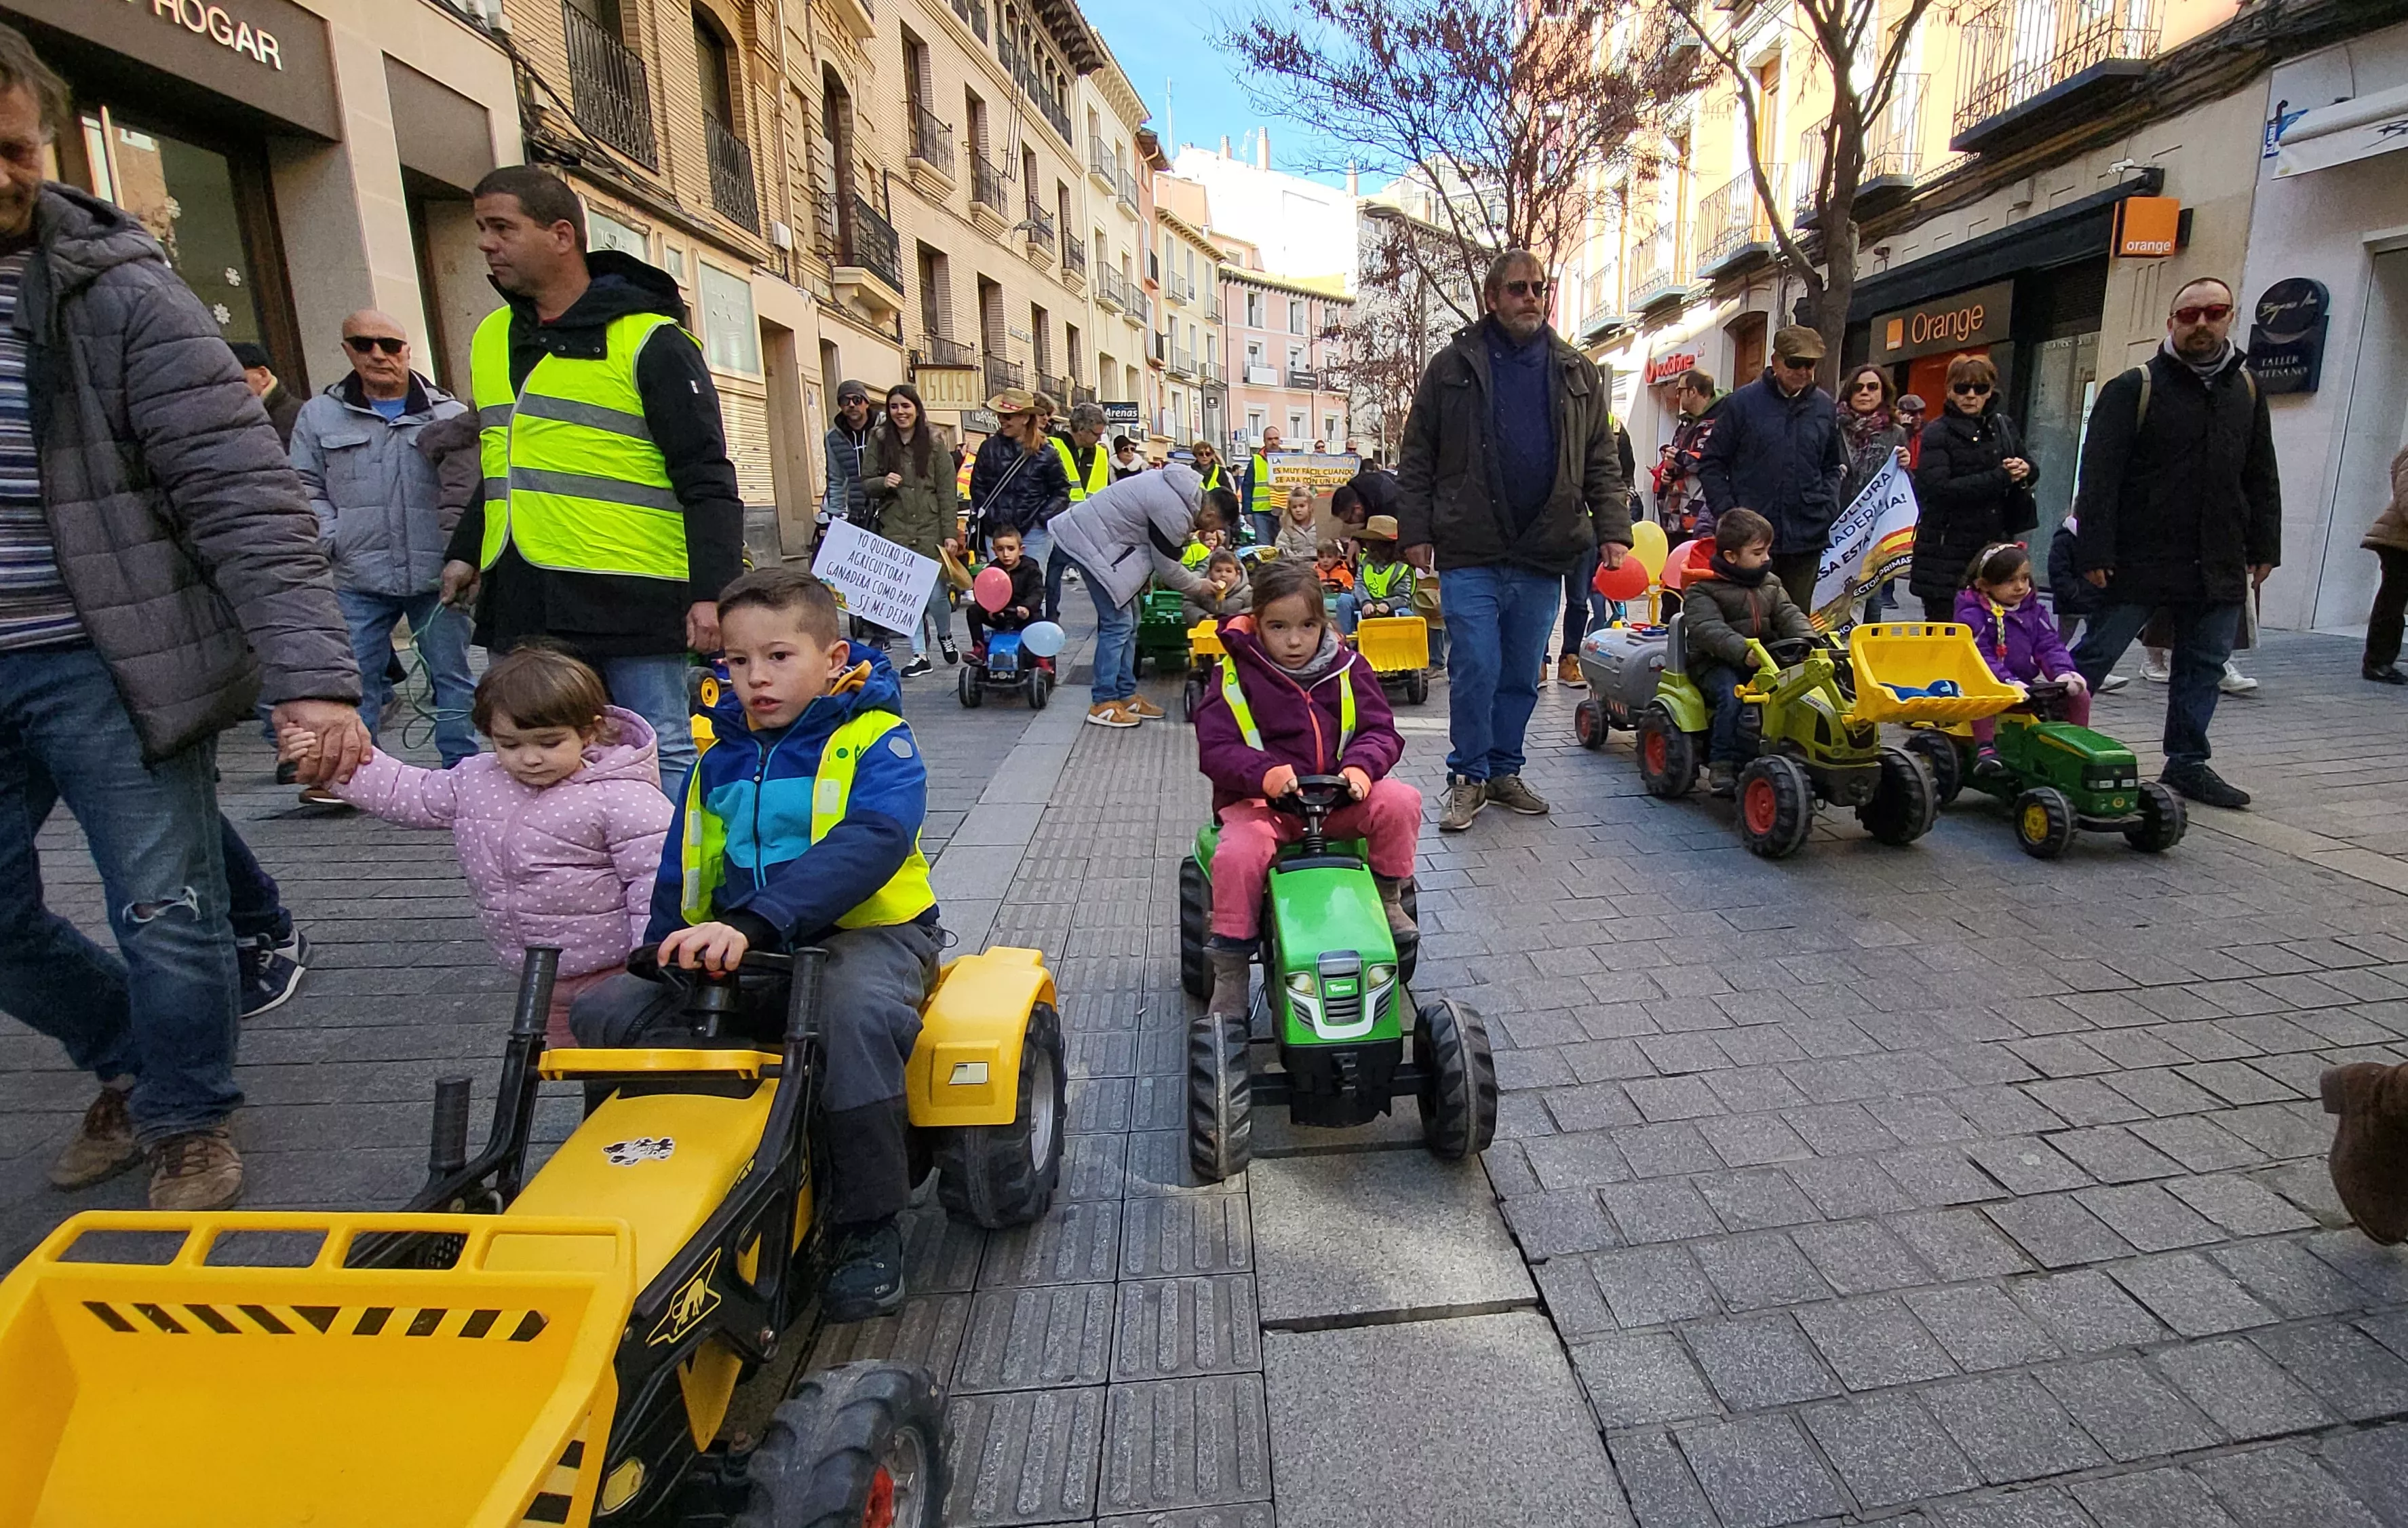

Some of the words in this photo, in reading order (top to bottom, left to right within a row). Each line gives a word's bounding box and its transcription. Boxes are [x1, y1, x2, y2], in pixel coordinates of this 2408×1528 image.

[151, 0, 282, 70] HOGAR
[2126, 240, 2171, 254] orange
[1911, 305, 1984, 343] Orange
[1105, 407, 1138, 417] Arenas
[1333, 476, 1351, 484] LÁPI
[847, 550, 903, 583] AGRICULTORA
[904, 573, 911, 586] Y
[857, 533, 868, 546] YO
[870, 537, 901, 562] QUIERO
[900, 550, 916, 568] SER
[826, 561, 870, 590] GANADERA
[872, 580, 896, 600] COMO
[897, 591, 920, 609] PAPÁ
[871, 599, 885, 617] ME
[887, 605, 916, 628] DEJAN
